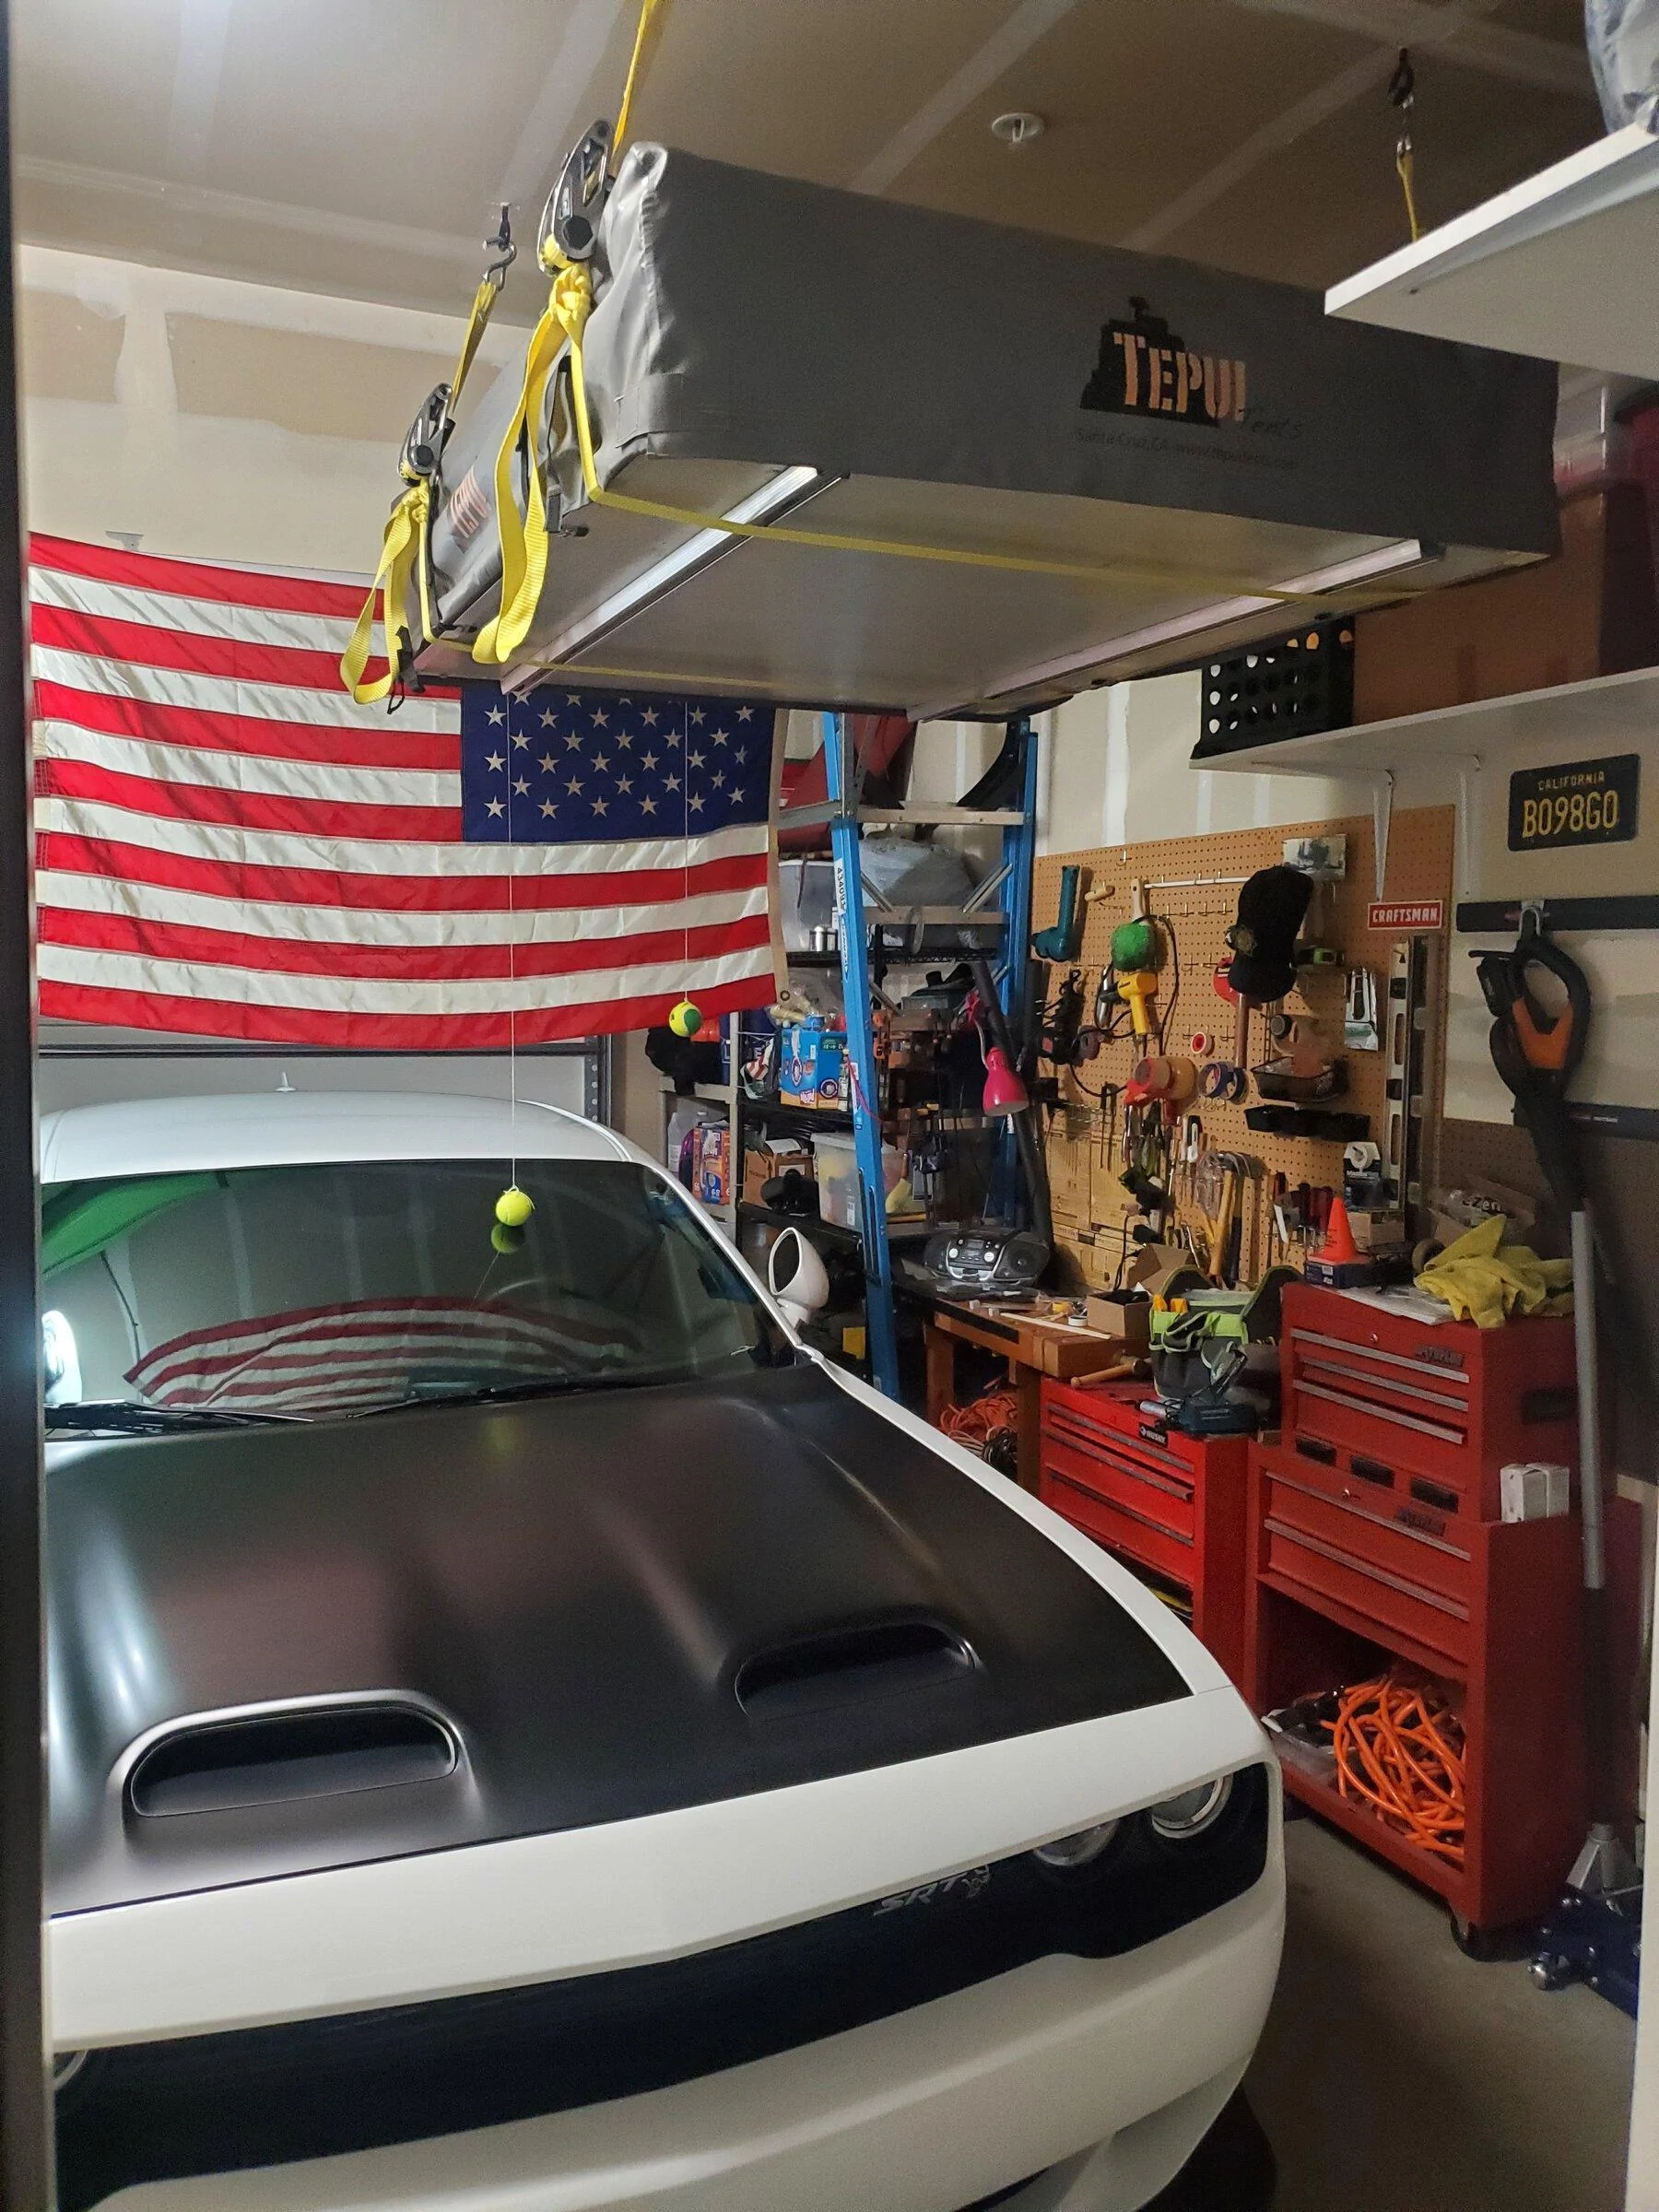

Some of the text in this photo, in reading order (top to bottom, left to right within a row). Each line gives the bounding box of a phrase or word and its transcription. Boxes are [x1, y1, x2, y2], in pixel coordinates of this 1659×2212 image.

[1113, 331, 1247, 423] TEPUI
[1537, 771, 1606, 791] CALIFORNIA
[1372, 908, 1438, 923] CRAFTSMAN
[873, 1872, 968, 1916] SRT
